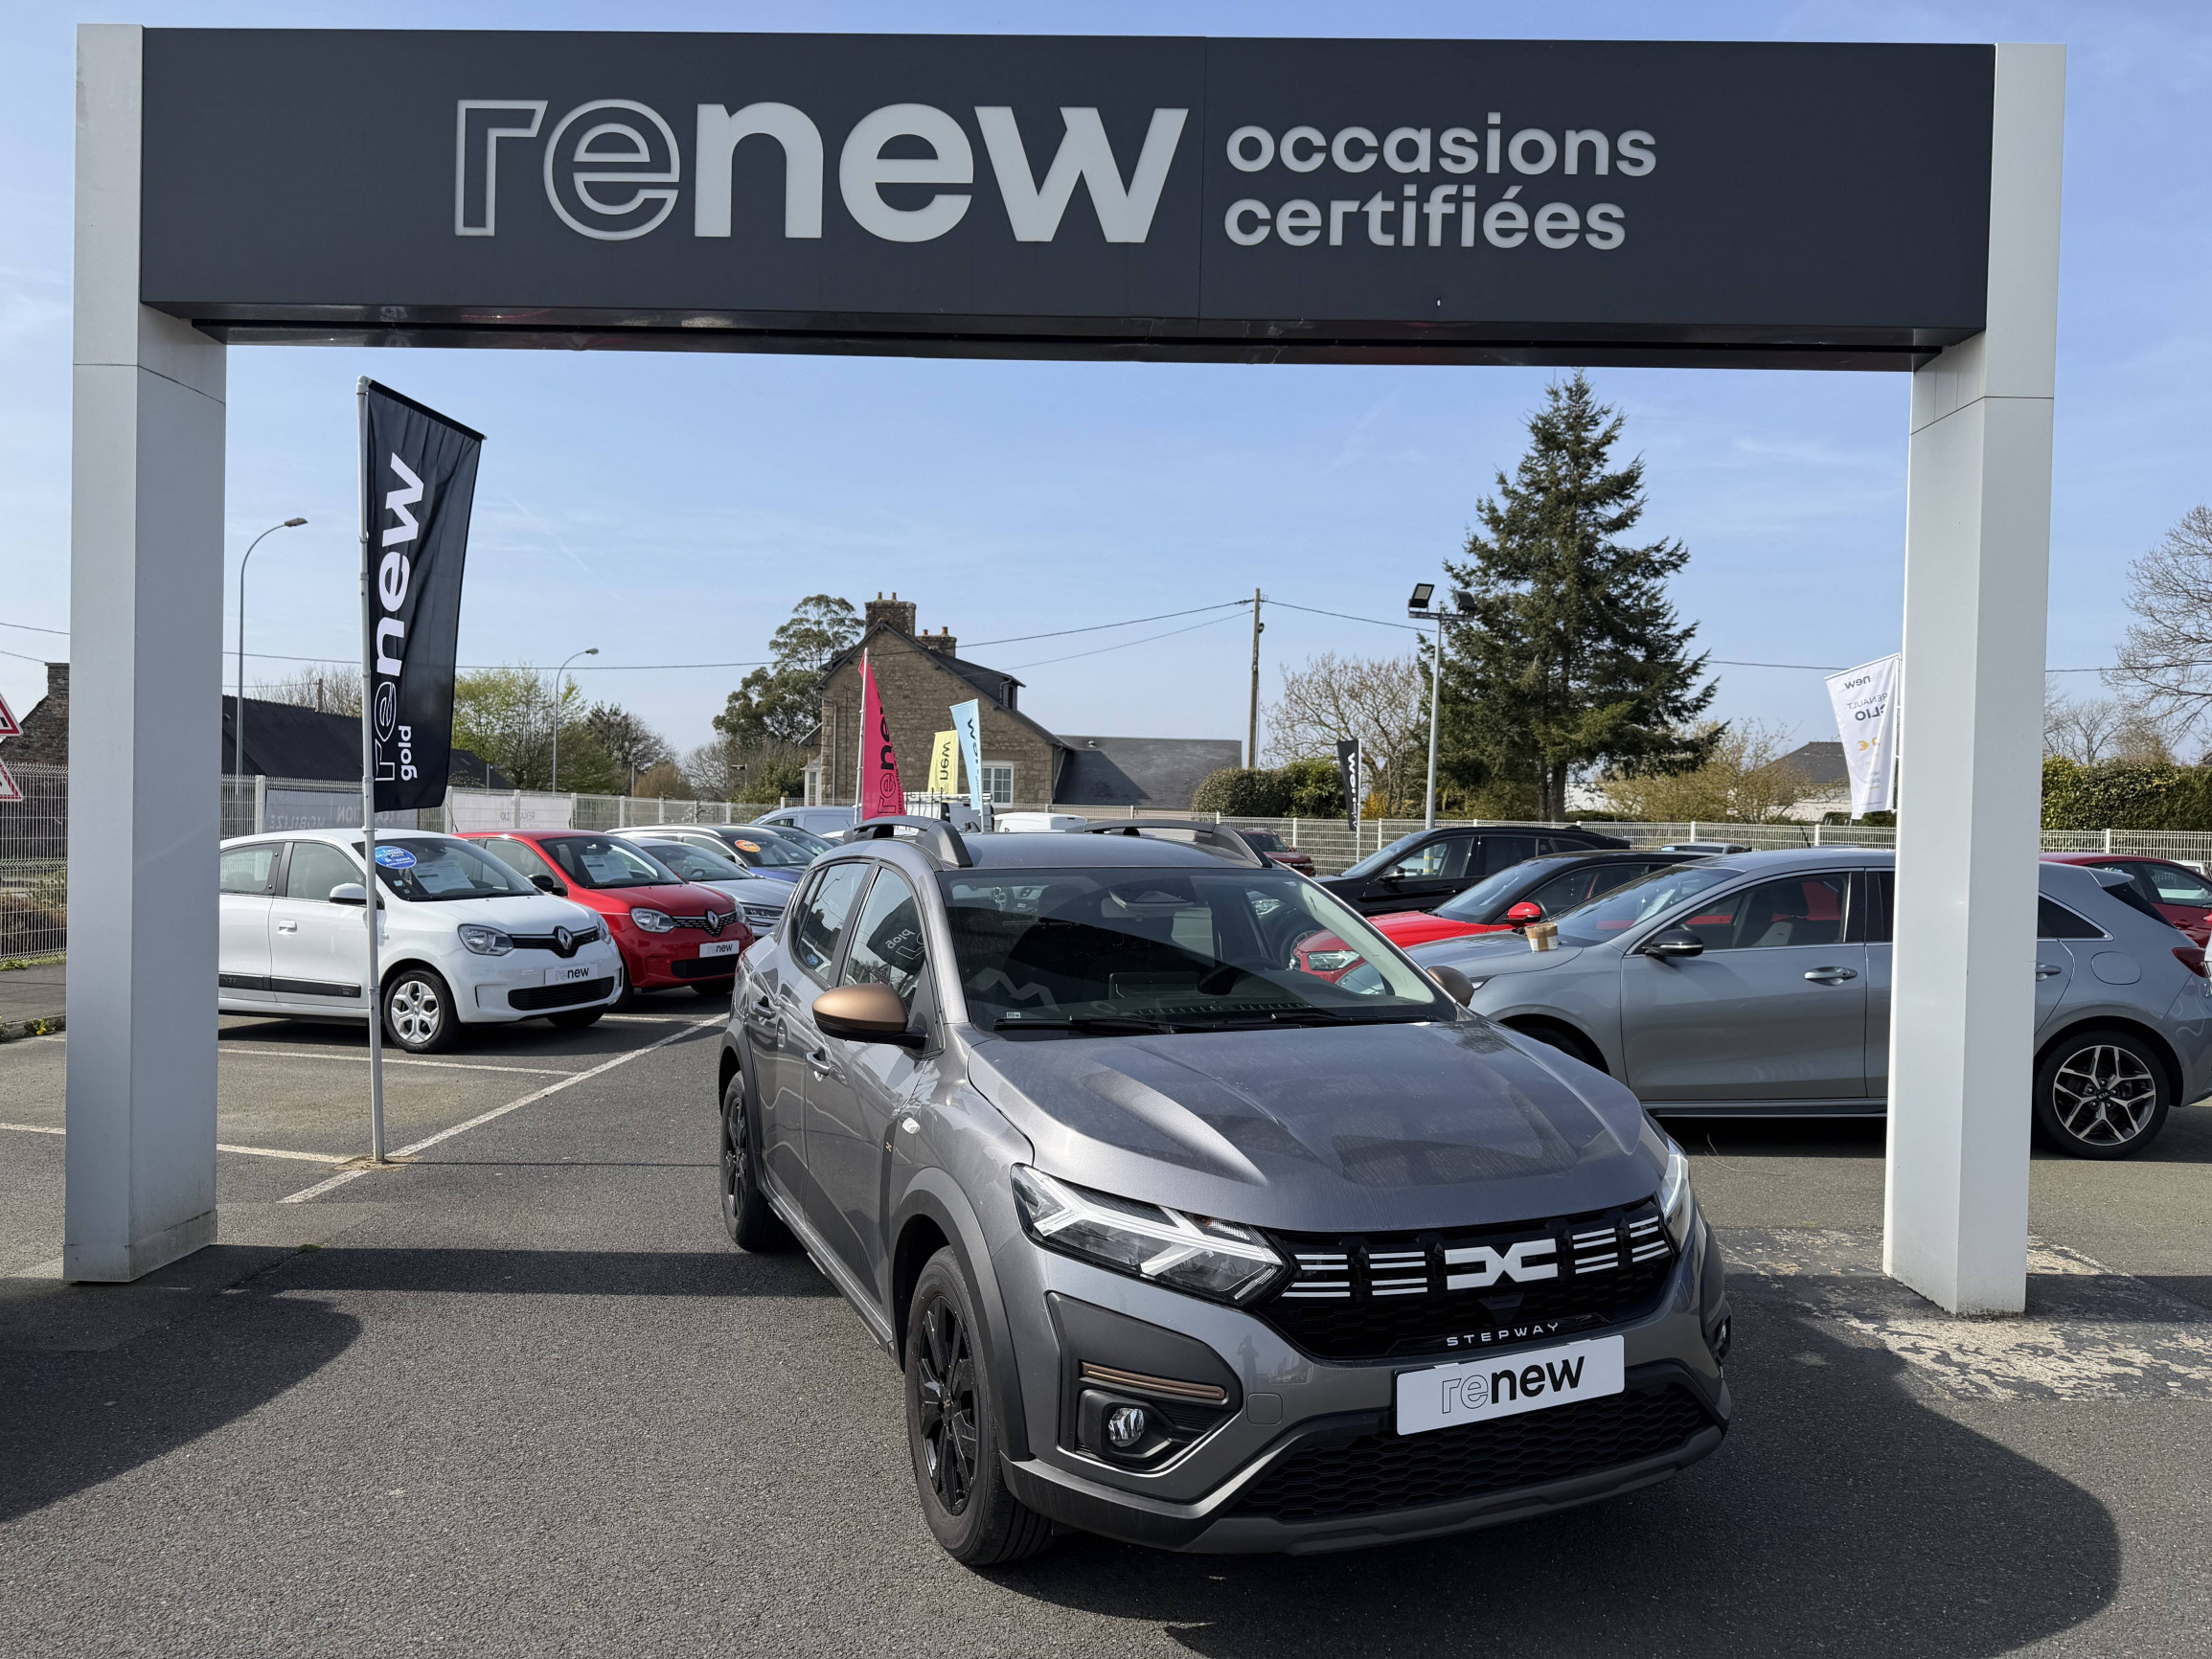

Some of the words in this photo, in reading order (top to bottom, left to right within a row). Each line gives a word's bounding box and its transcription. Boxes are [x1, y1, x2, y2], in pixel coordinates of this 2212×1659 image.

[455, 99, 1189, 243] renew
[1225, 111, 1657, 177] occasions
[1223, 183, 1627, 250] certifiées
[375, 451, 424, 781] renew
[398, 725, 418, 781] gold
[1446, 1322, 1559, 1347] STEPWAY
[1442, 1355, 1585, 1414] renew
